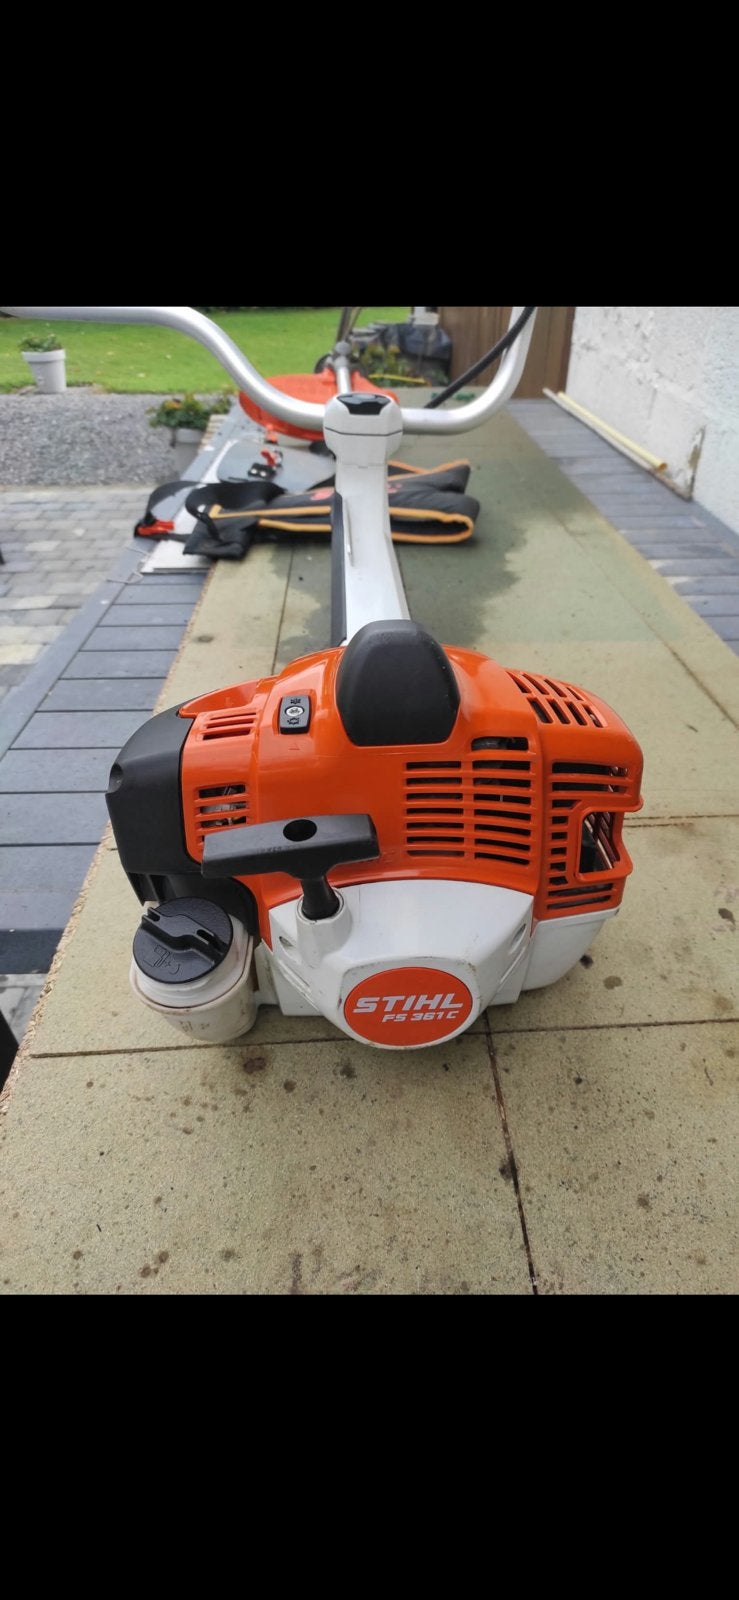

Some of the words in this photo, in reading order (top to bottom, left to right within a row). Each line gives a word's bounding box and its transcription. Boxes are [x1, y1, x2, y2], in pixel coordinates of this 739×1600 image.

[353, 993, 463, 1013] STIHL
[382, 1014, 407, 1022] FS
[410, 1012, 444, 1021] 361
[446, 1011, 459, 1019] C
